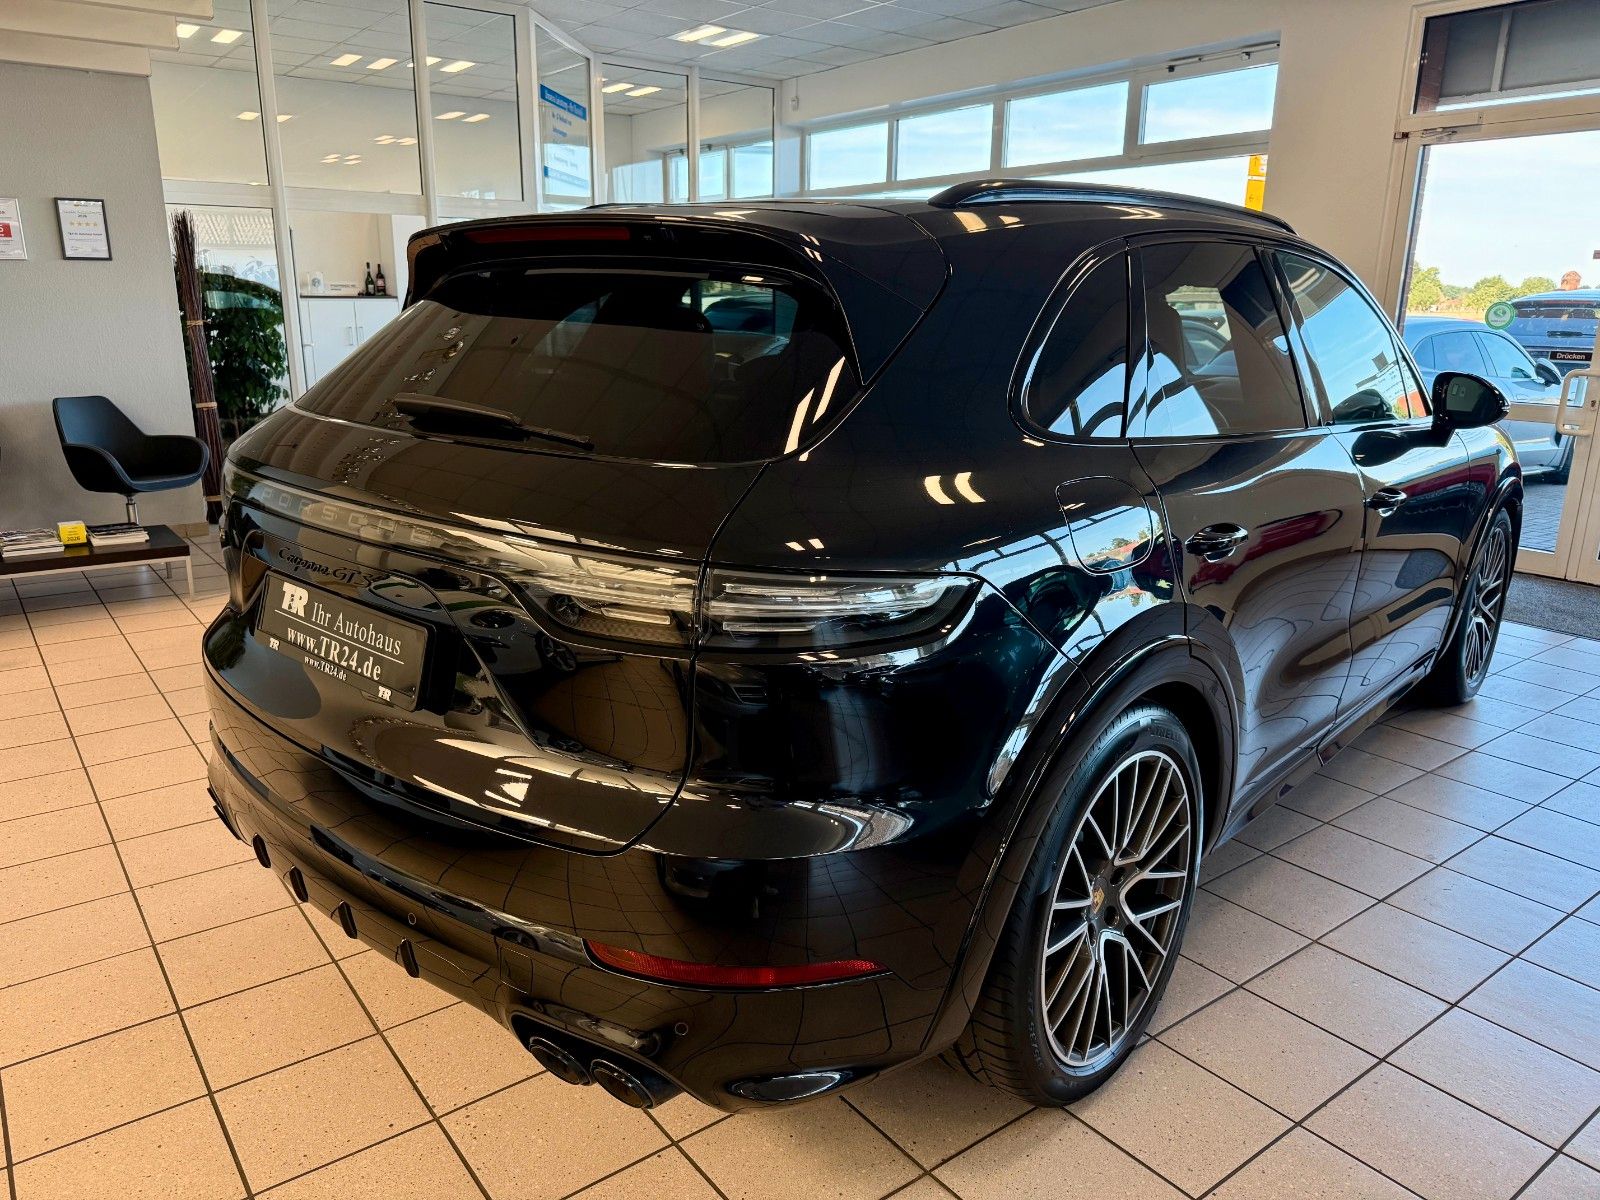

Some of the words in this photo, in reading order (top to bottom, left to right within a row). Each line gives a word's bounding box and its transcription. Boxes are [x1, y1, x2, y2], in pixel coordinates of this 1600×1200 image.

[1556, 352, 1586, 360] Drücken
[260, 487, 433, 546] PORSCHE
[286, 626, 382, 681] www.TR24.de
[311, 601, 332, 627] Ihr
[334, 610, 402, 656] Autohaus
[304, 655, 348, 682] www.TR24.de
